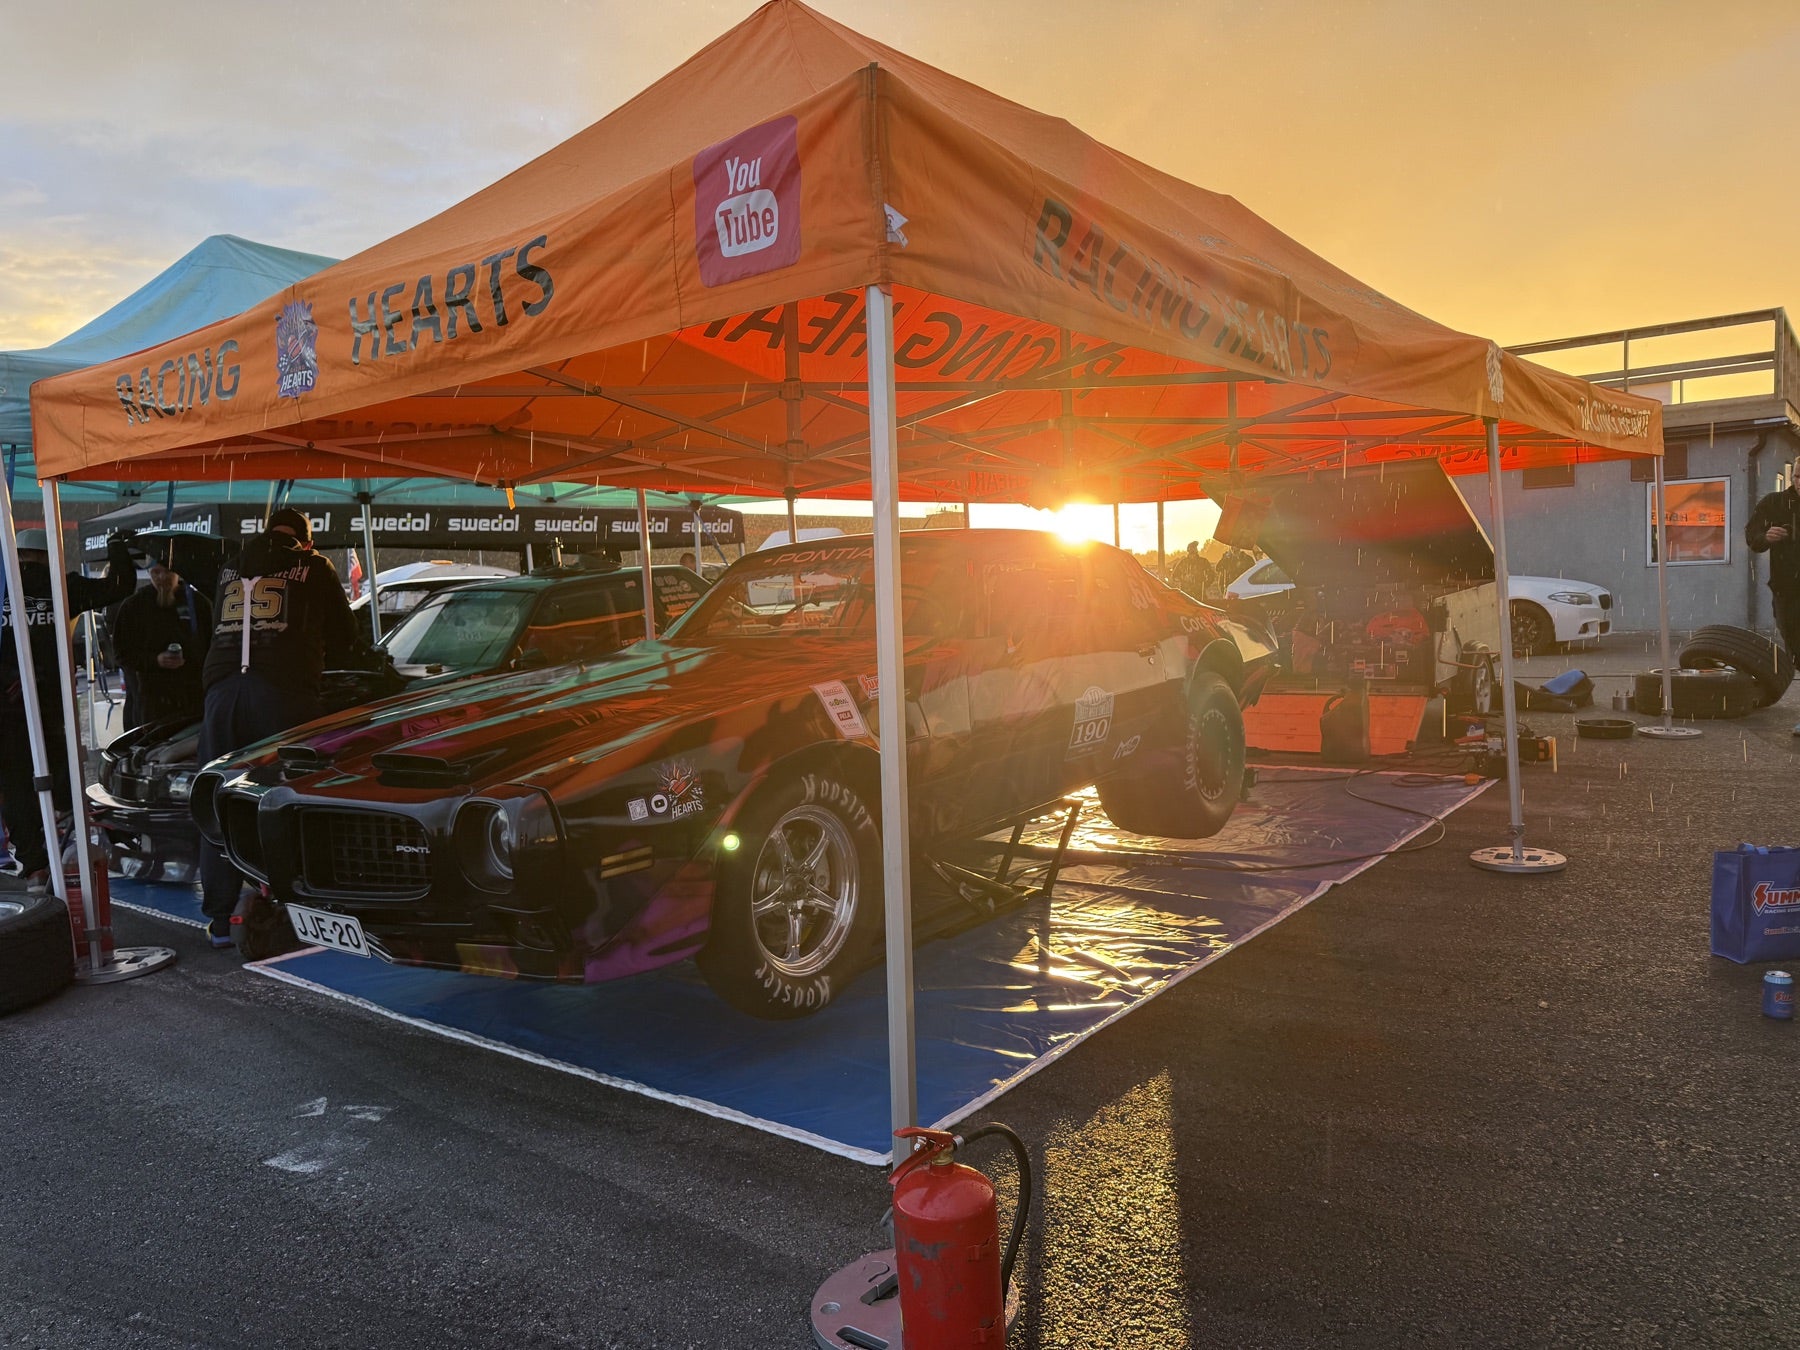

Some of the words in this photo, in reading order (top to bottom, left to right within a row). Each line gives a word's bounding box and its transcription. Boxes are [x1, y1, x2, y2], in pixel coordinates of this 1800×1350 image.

[725, 155, 761, 196] You
[718, 203, 776, 248] Tube
[115, 339, 241, 427] RACING
[349, 234, 555, 366] HEARTS
[281, 370, 313, 393] HEARTS
[240, 512, 331, 535] sol
[350, 512, 431, 532] swedol
[448, 513, 520, 532] swedol
[534, 514, 599, 533] swedol
[771, 546, 875, 566] PONTIA
[221, 577, 288, 622] 25
[1074, 719, 1108, 745] 190
[671, 799, 704, 819] HEARTS
[395, 845, 431, 854] PONTI
[1754, 883, 1800, 912] SUMM
[298, 912, 361, 949] JJE-20
